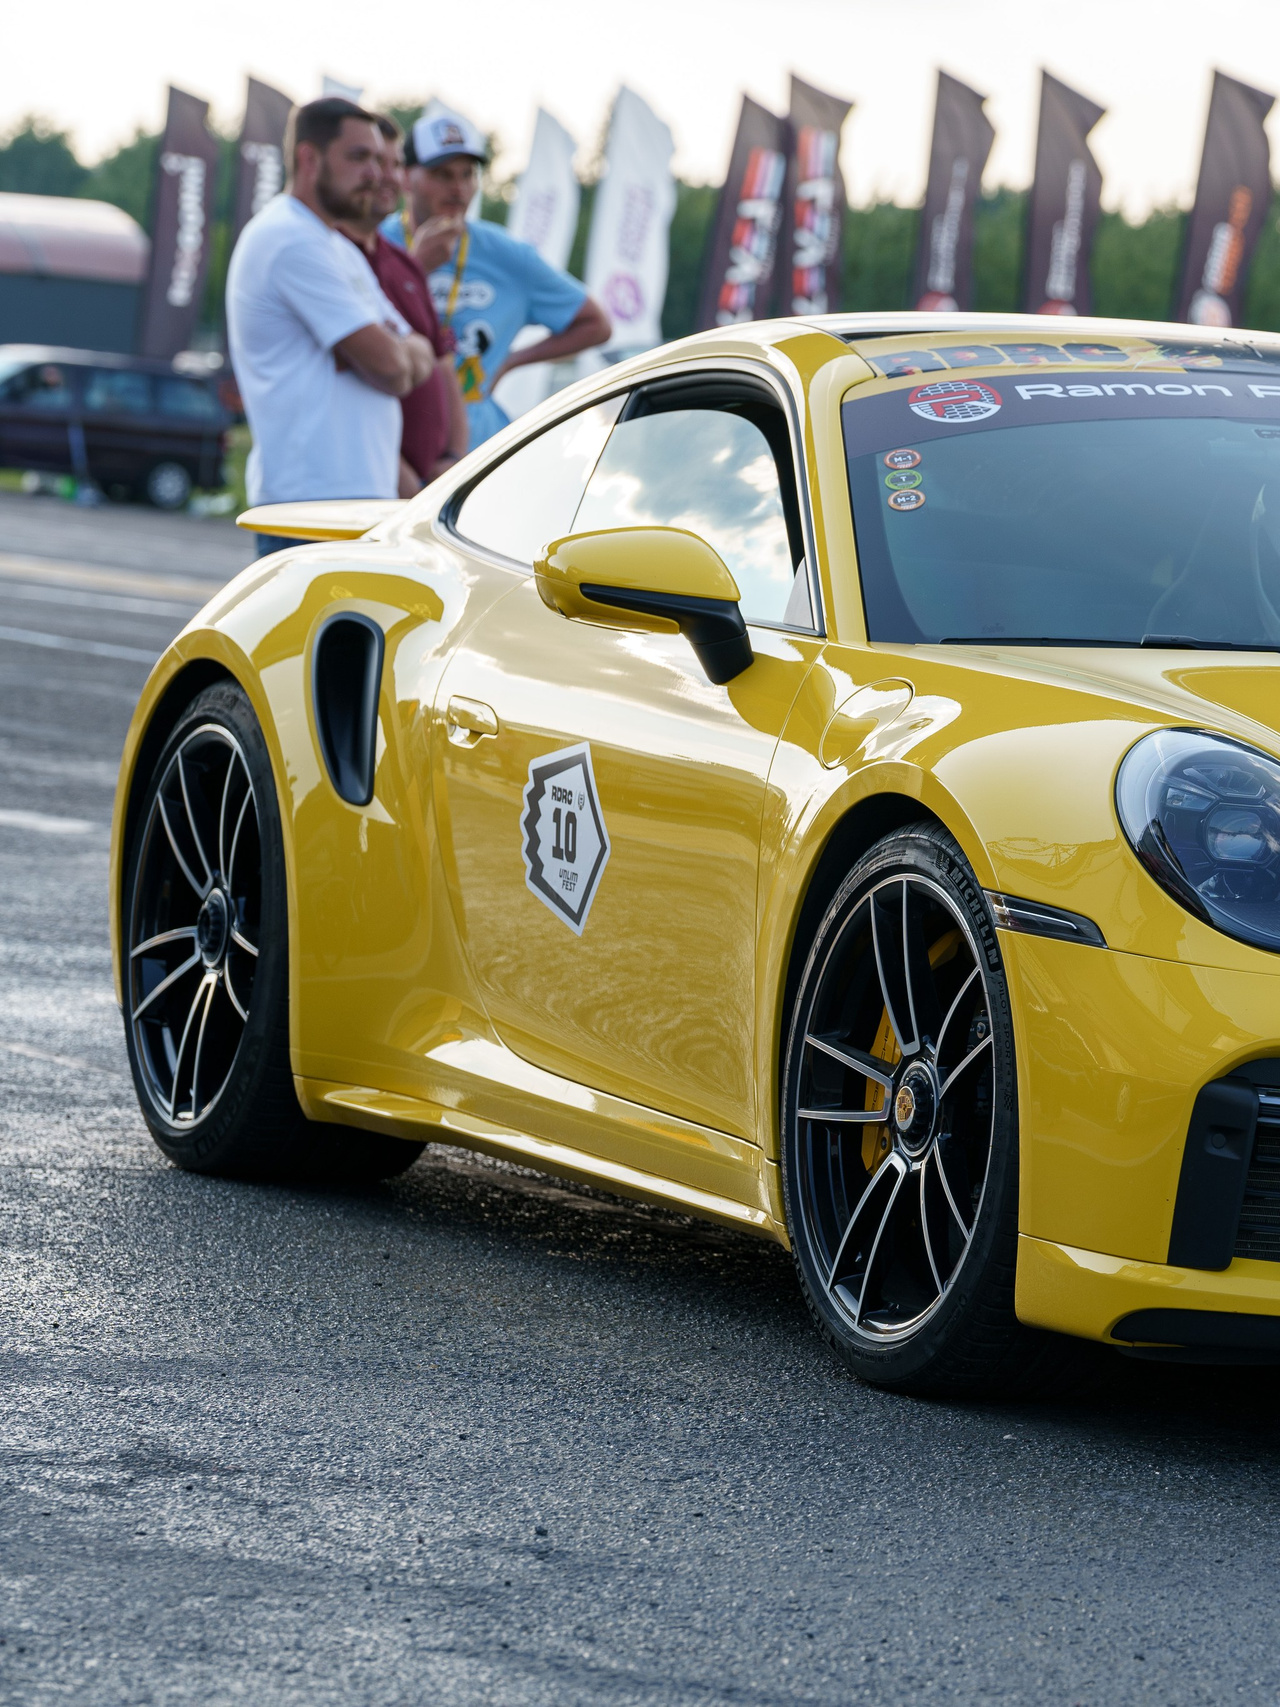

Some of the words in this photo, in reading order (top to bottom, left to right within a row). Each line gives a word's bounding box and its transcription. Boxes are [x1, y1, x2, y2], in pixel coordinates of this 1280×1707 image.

[1014, 383, 1233, 400] Ramon
[551, 785, 573, 806] RDRC
[552, 807, 577, 864] 10
[561, 879, 576, 893] FEST
[950, 867, 999, 966] MICHELIN
[997, 981, 1008, 1016] PILOT
